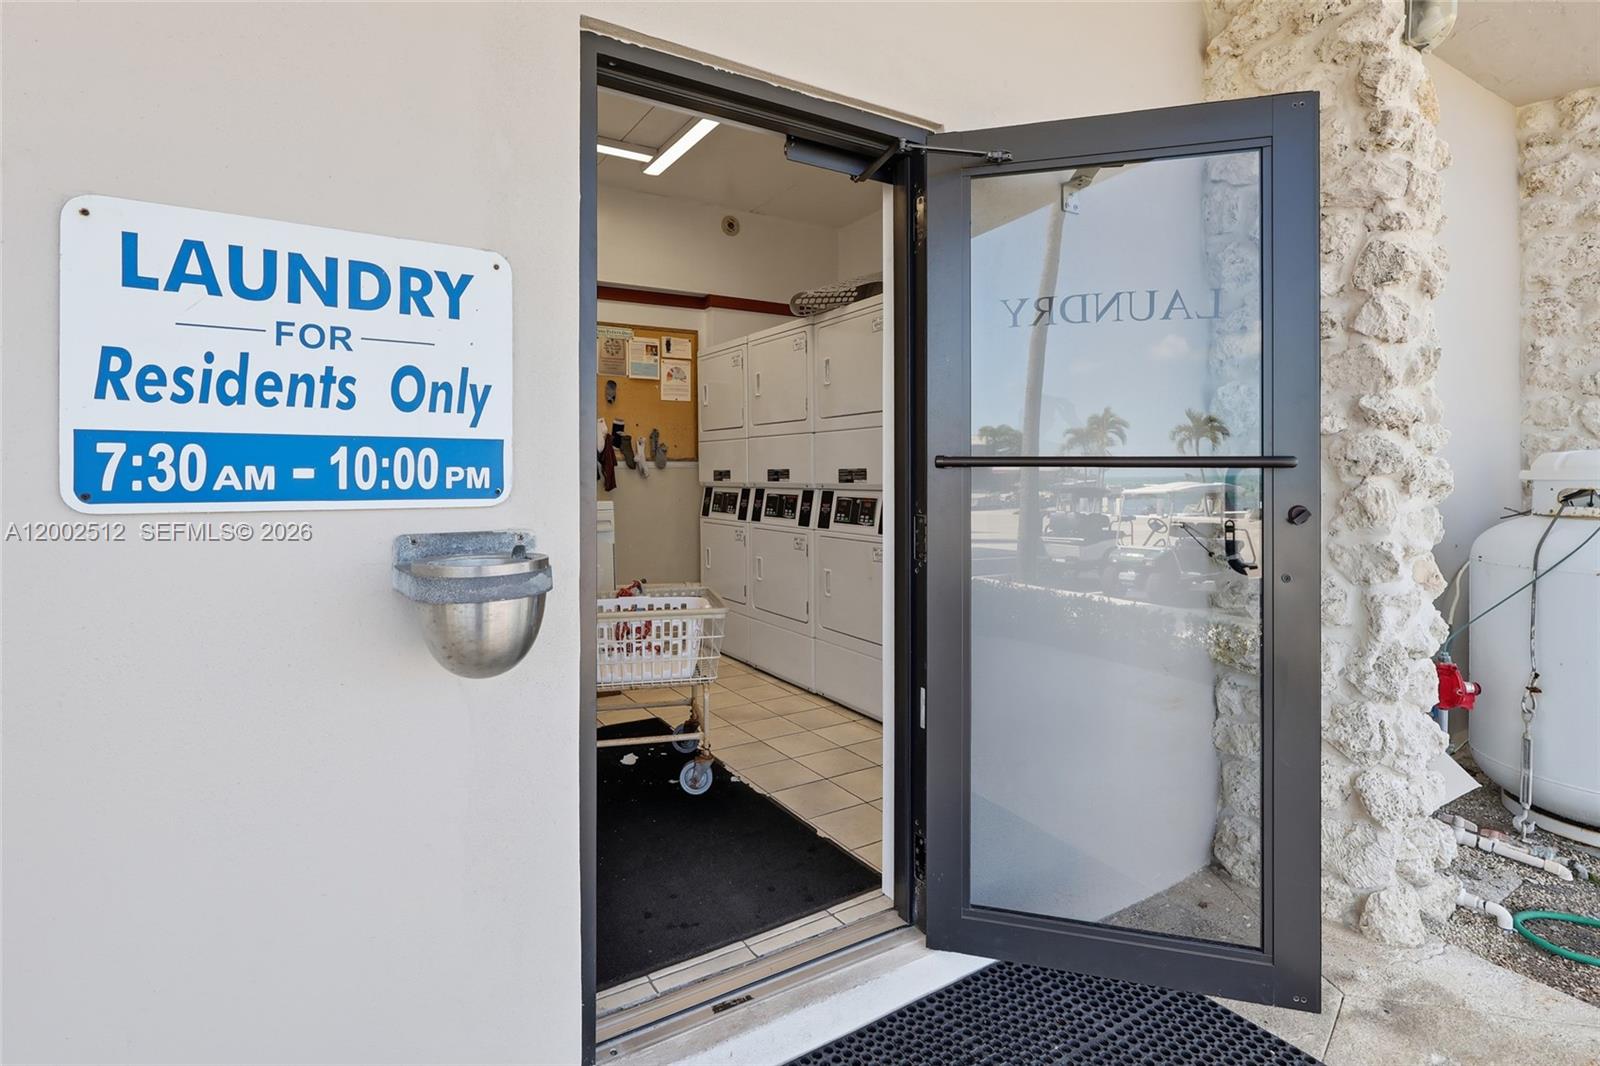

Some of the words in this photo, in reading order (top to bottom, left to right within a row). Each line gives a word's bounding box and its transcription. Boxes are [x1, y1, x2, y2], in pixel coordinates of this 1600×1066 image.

[121, 231, 473, 320] LAUNDRY
[275, 321, 353, 352] FOR
[94, 345, 357, 412] Residents
[390, 363, 492, 428] Only
[96, 442, 207, 492] 7:30
[213, 465, 275, 491] AM
[330, 446, 439, 490] 10:00
[445, 466, 491, 489] PM
